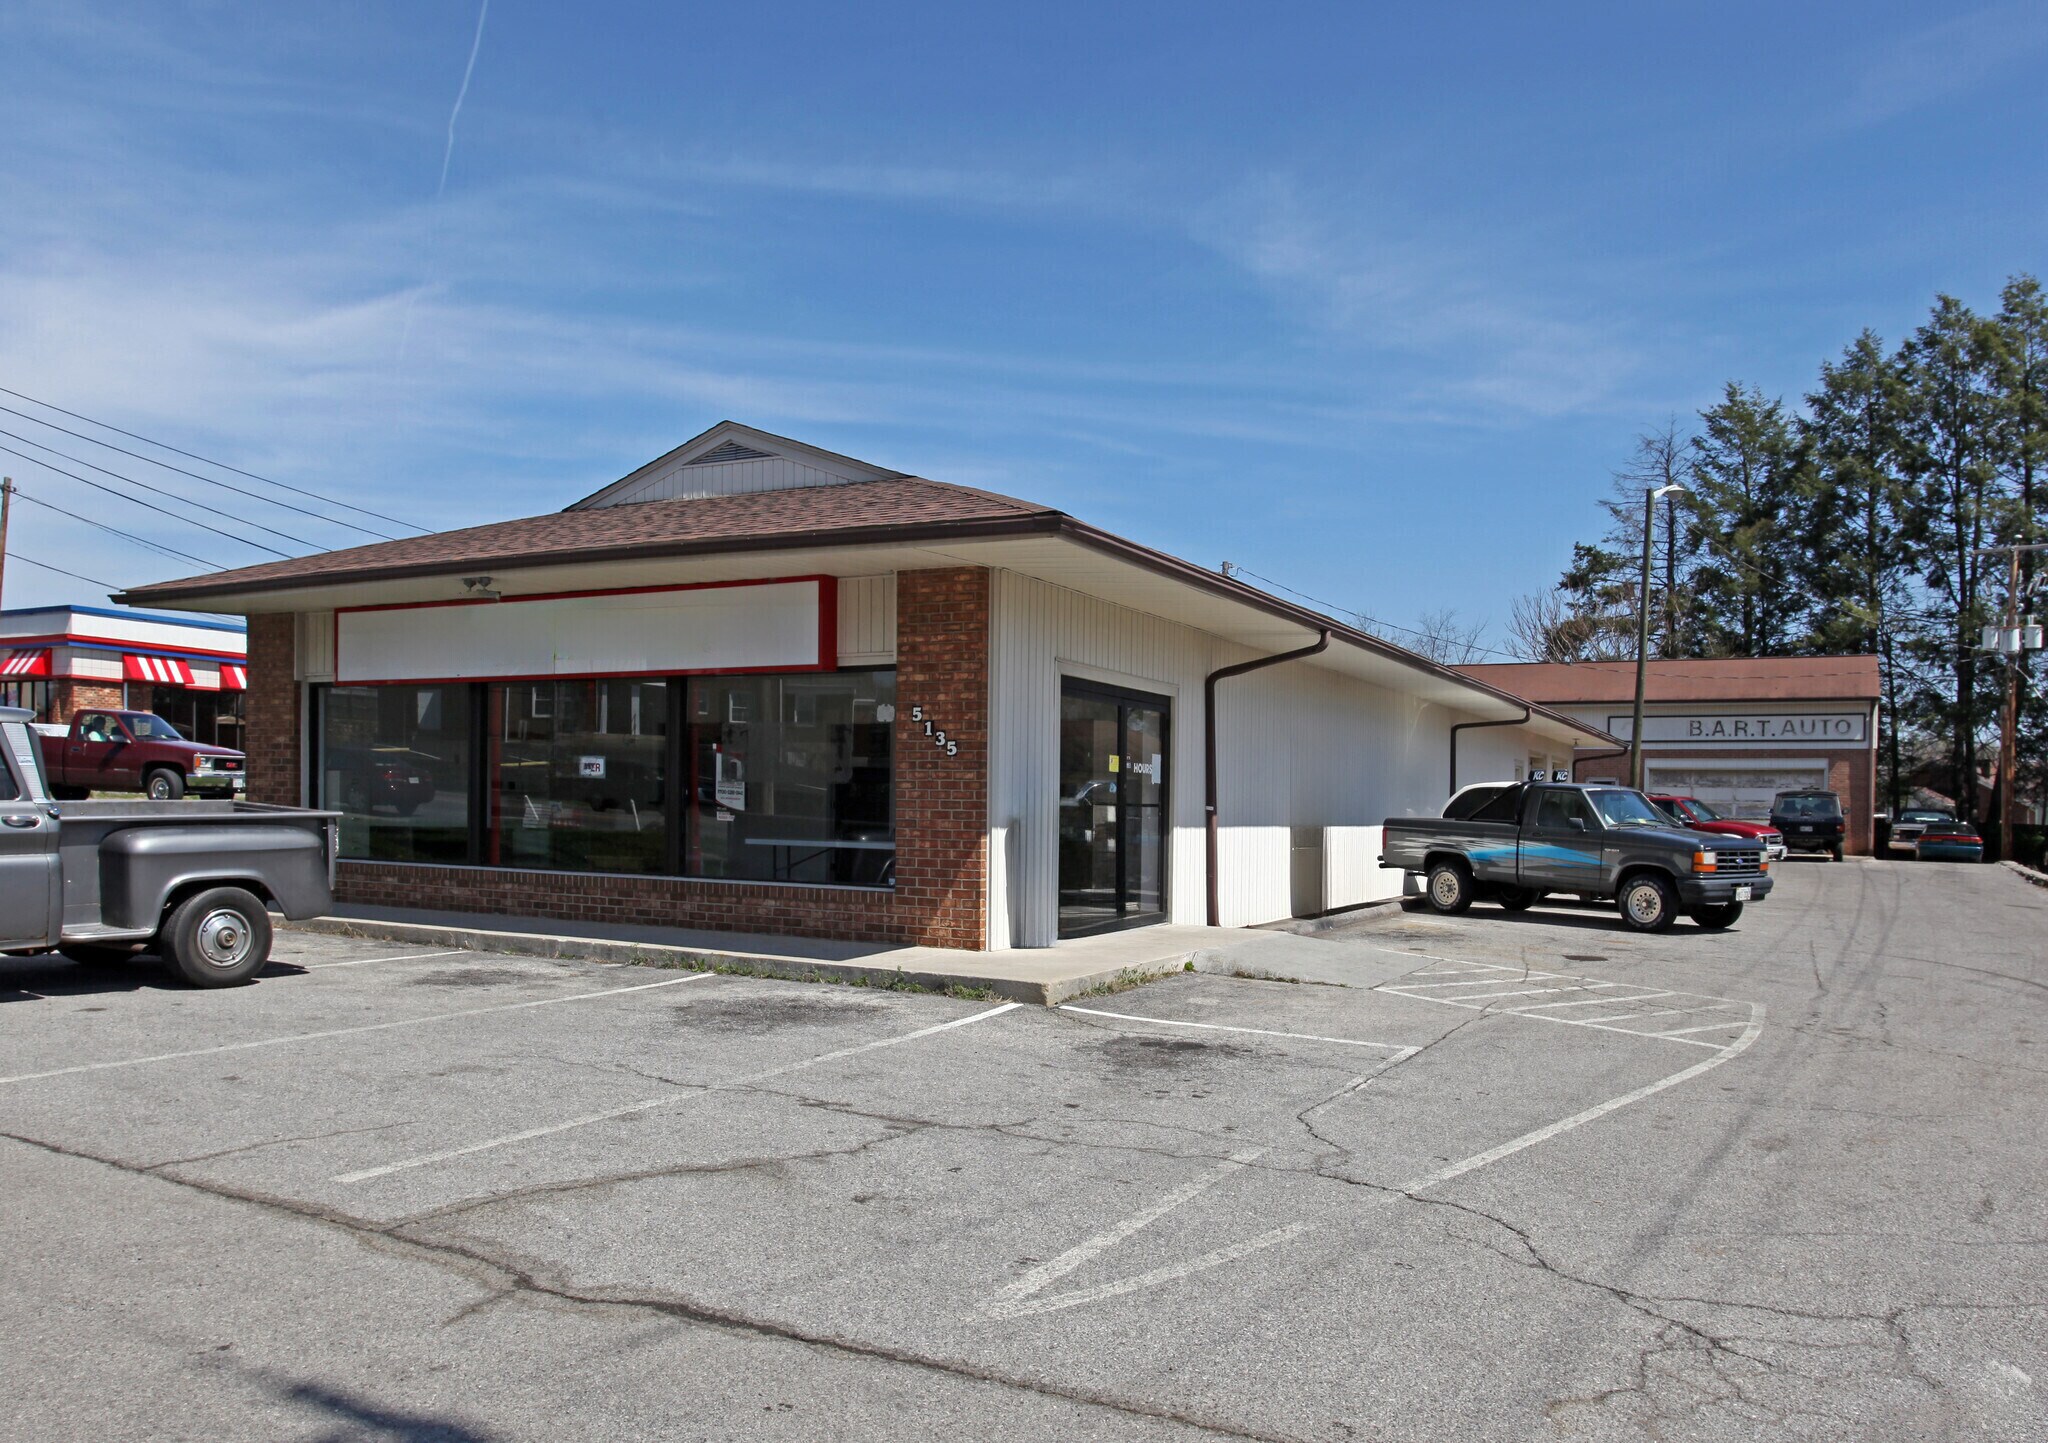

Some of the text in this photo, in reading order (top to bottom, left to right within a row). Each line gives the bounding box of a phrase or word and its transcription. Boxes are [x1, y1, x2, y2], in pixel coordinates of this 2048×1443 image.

[911, 706, 958, 757] 5135
[1779, 719, 1852, 736] AUTO
[1133, 762, 1153, 774] HOURS
[1532, 771, 1545, 781] KC
[1556, 771, 1568, 781] KC
